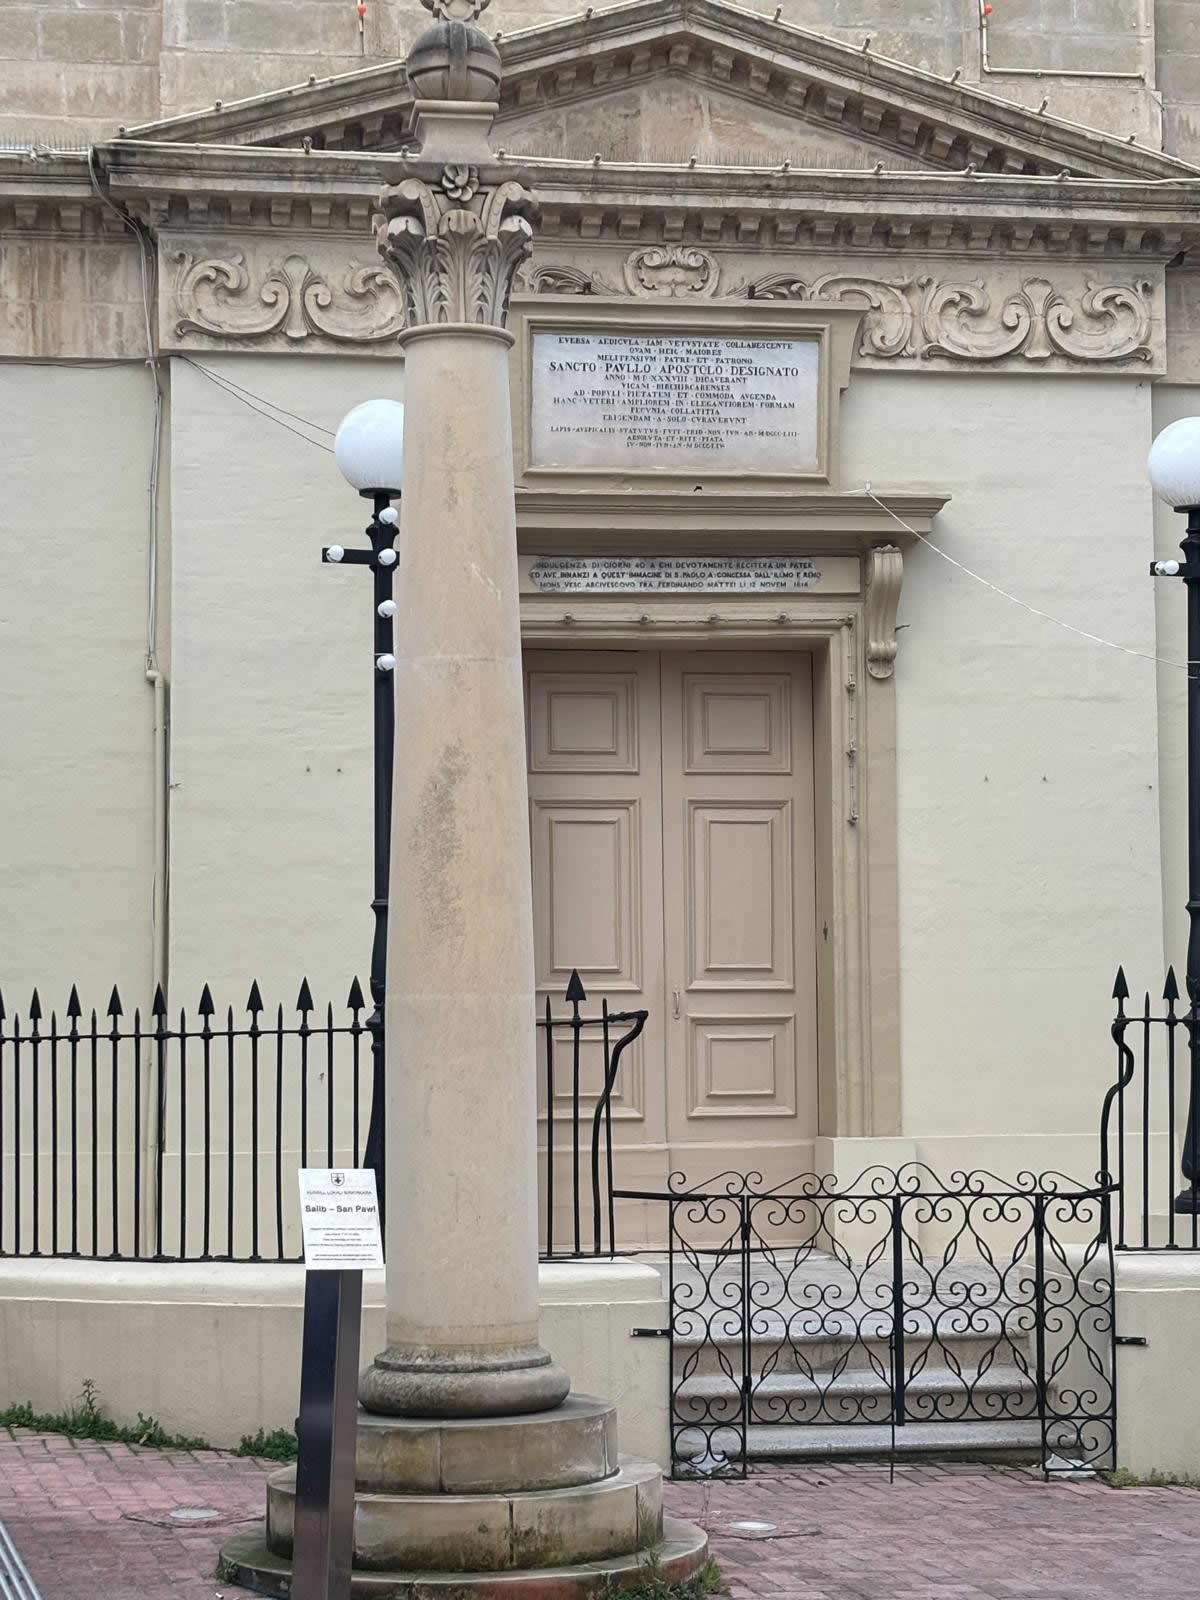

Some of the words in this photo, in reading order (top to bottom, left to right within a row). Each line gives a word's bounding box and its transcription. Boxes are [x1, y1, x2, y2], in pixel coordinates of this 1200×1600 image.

[726, 342, 792, 350] COLLABESCENTE
[549, 362, 596, 372] SANCTO
[605, 363, 651, 373] PAVLLO
[660, 364, 723, 375] APOSTOLO
[730, 366, 799, 376] DESIGNATO
[695, 376, 748, 384] DICAVERANT
[690, 400, 754, 408] ELEGANTIOREM
